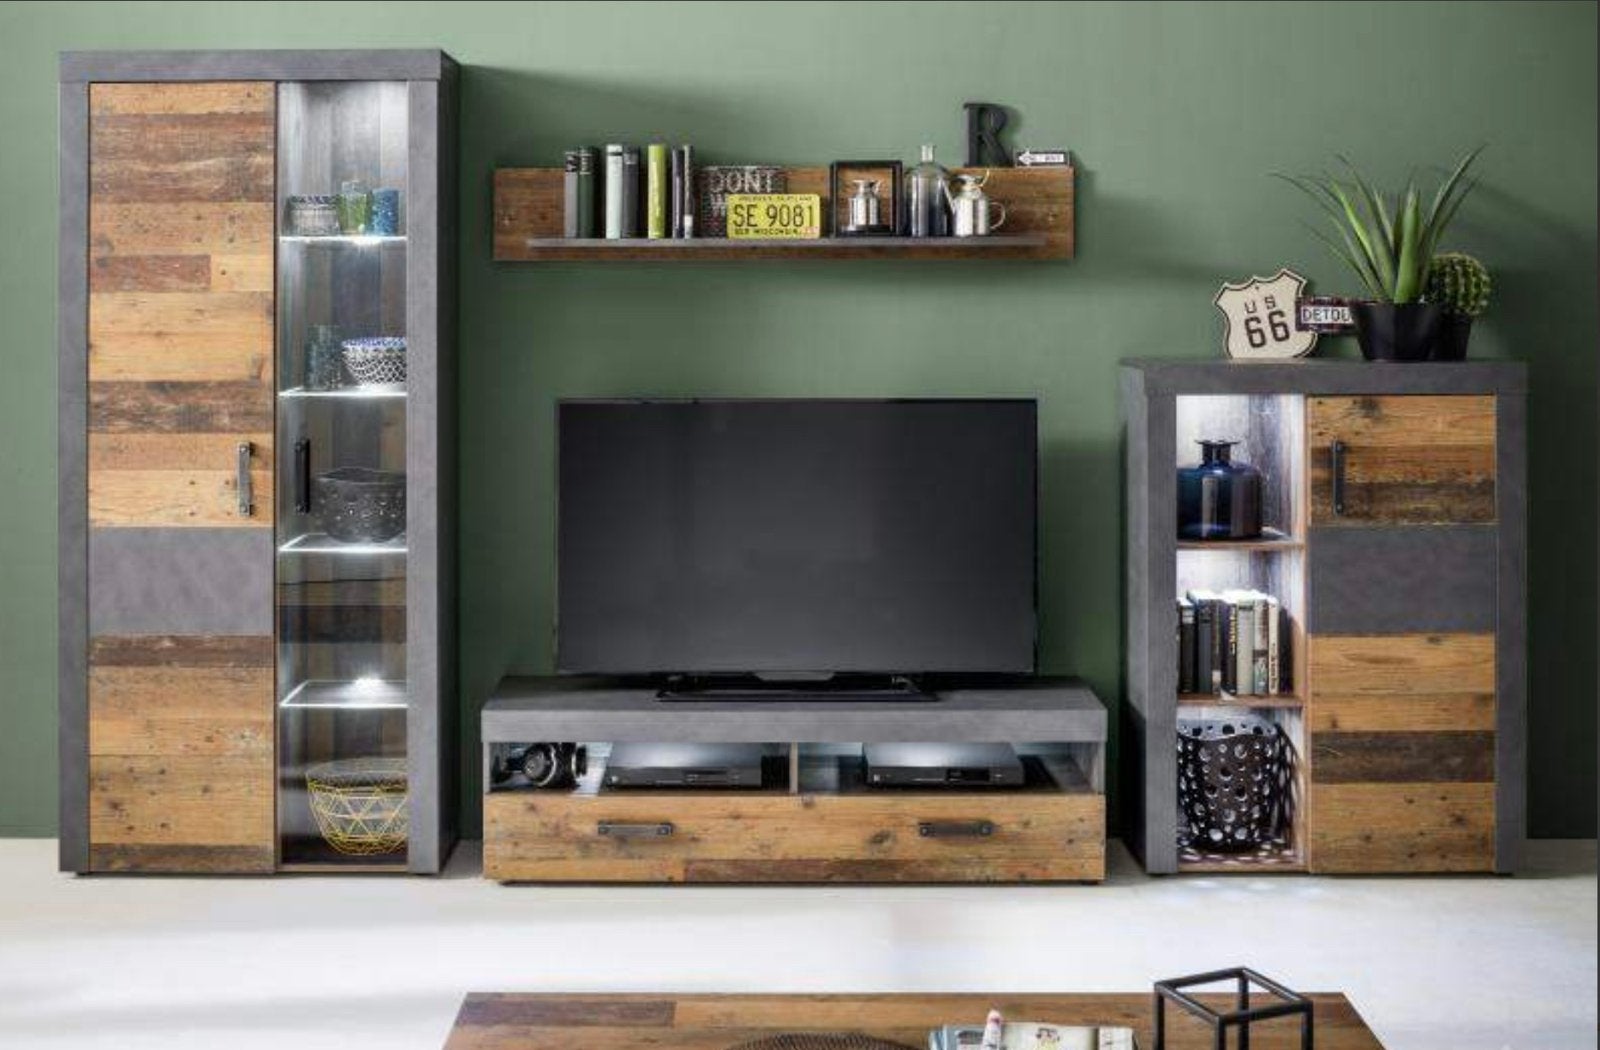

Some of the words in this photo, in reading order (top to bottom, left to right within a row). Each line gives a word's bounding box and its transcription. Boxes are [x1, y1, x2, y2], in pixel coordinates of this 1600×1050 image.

[963, 102, 1014, 167] R
[733, 204, 758, 227] SE
[766, 204, 814, 227] 9081
[1244, 310, 1290, 348] 66
[1302, 308, 1351, 322] DETOU
